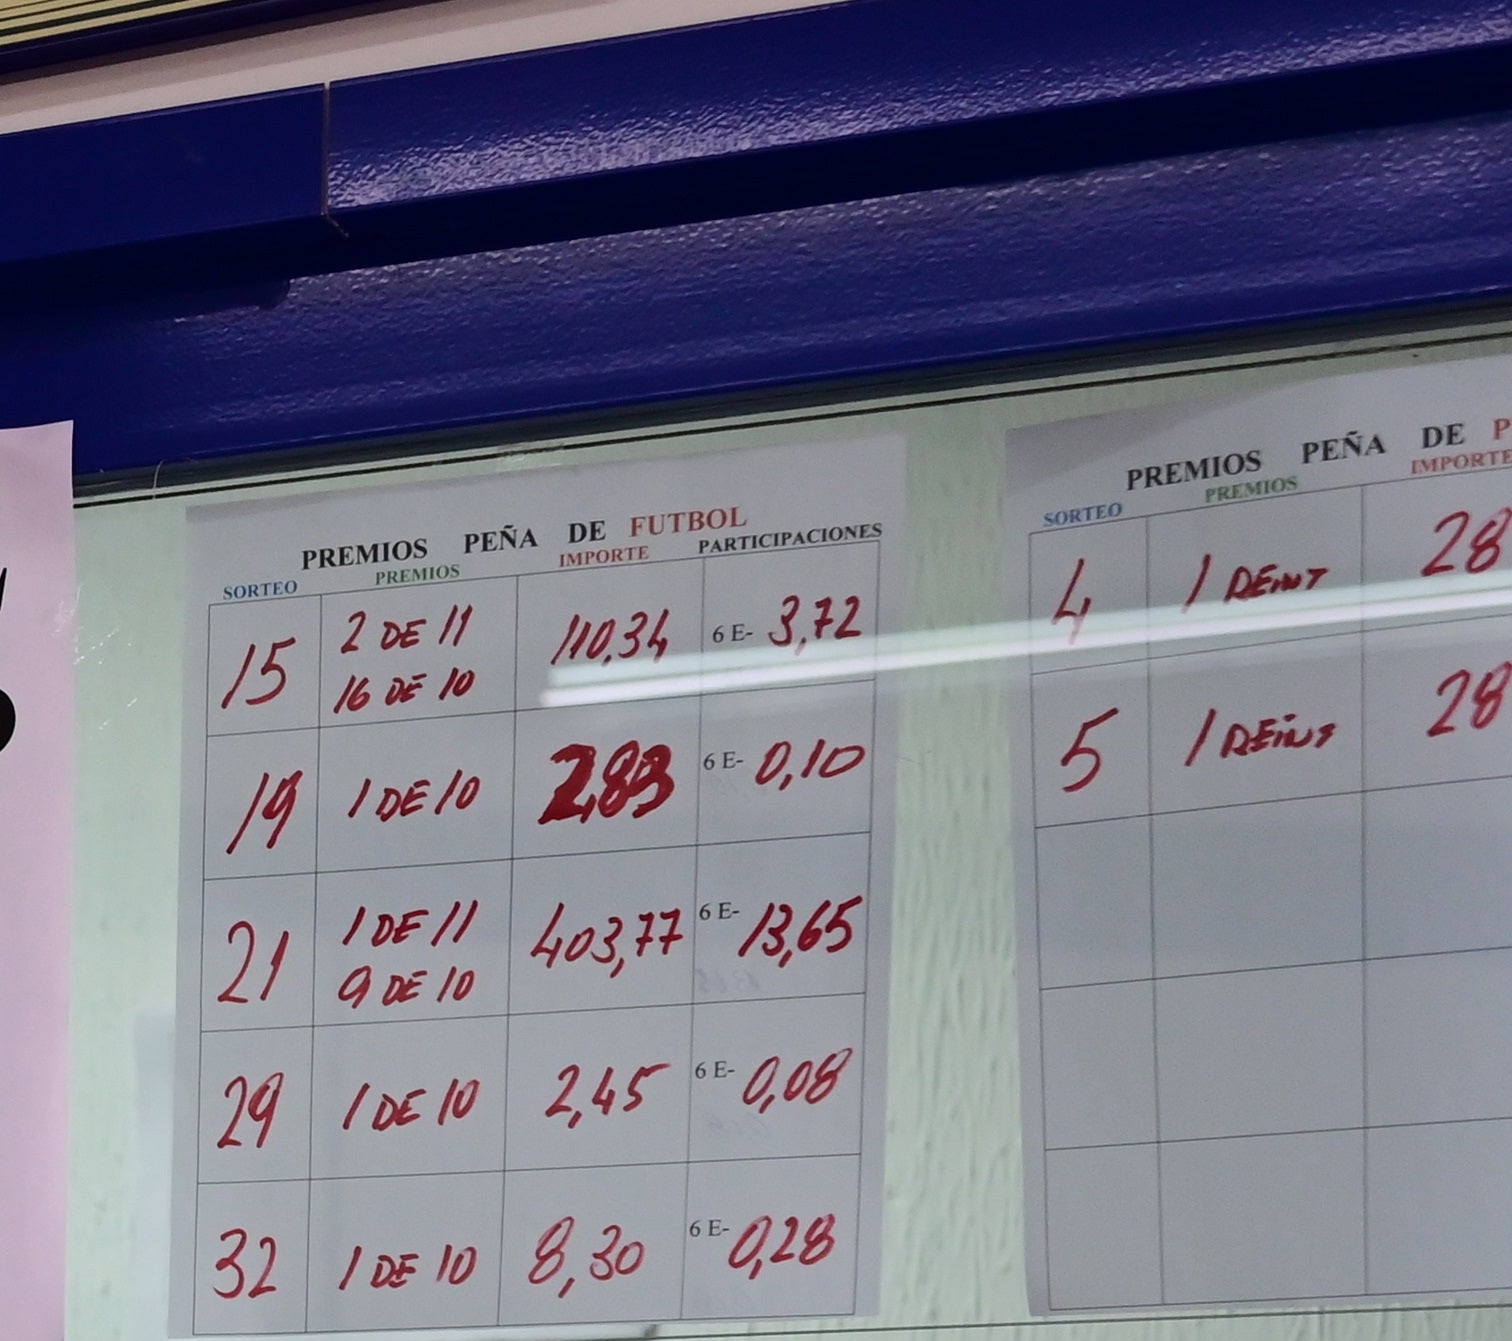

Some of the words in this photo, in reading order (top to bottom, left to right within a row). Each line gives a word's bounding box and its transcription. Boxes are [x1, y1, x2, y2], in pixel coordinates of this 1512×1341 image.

[1126, 450, 1262, 491] PREMIOS
[1301, 430, 1387, 465] PEÑA
[1421, 423, 1465, 450] DE
[1205, 476, 1298, 504] PREMIOS
[301, 537, 429, 571] PREMIOS
[464, 524, 538, 555] PEÑA
[568, 519, 606, 545] DE
[629, 505, 748, 537] FUTBOL
[697, 522, 883, 555] PARTICIPACIONES
[1044, 502, 1123, 528] SORTEO
[374, 563, 461, 587] PREMIOS
[559, 544, 650, 569] IMPORTE
[223, 579, 299, 601] SORTEO
[221, 637, 297, 709] 15
[227, 770, 303, 855] 19
[216, 920, 291, 1004] 21
[216, 1071, 285, 1149] 29
[213, 1227, 278, 1299] 32
